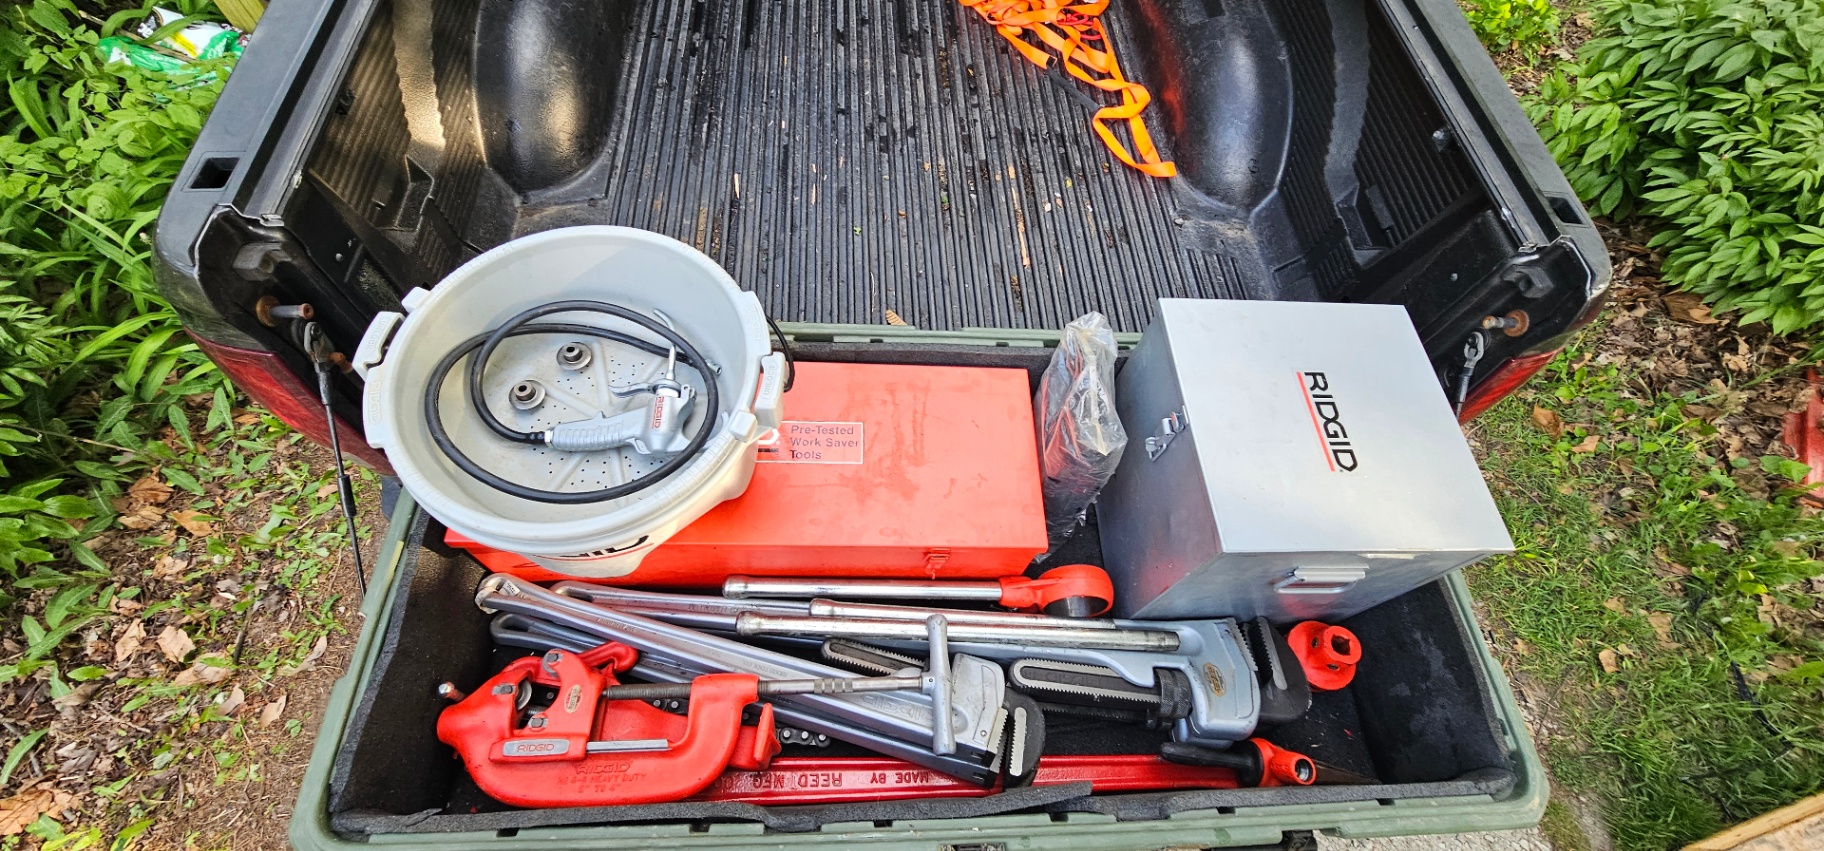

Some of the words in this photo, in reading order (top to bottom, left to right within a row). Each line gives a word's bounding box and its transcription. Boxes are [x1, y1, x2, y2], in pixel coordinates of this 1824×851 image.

[654, 396, 665, 429] RIDGID
[1304, 372, 1358, 472] RIDGID
[790, 425, 854, 435] Pre-Tested
[789, 437, 821, 447] Work
[826, 438, 859, 447] Saver
[789, 449, 822, 459] Tools
[516, 743, 555, 752] RIDGID
[575, 761, 631, 775] RIDGID
[590, 774, 619, 784] HEAVY
[621, 773, 647, 782] DUTY
[797, 772, 843, 788] REED
[869, 773, 887, 785] BY
[895, 771, 929, 784] MADE
